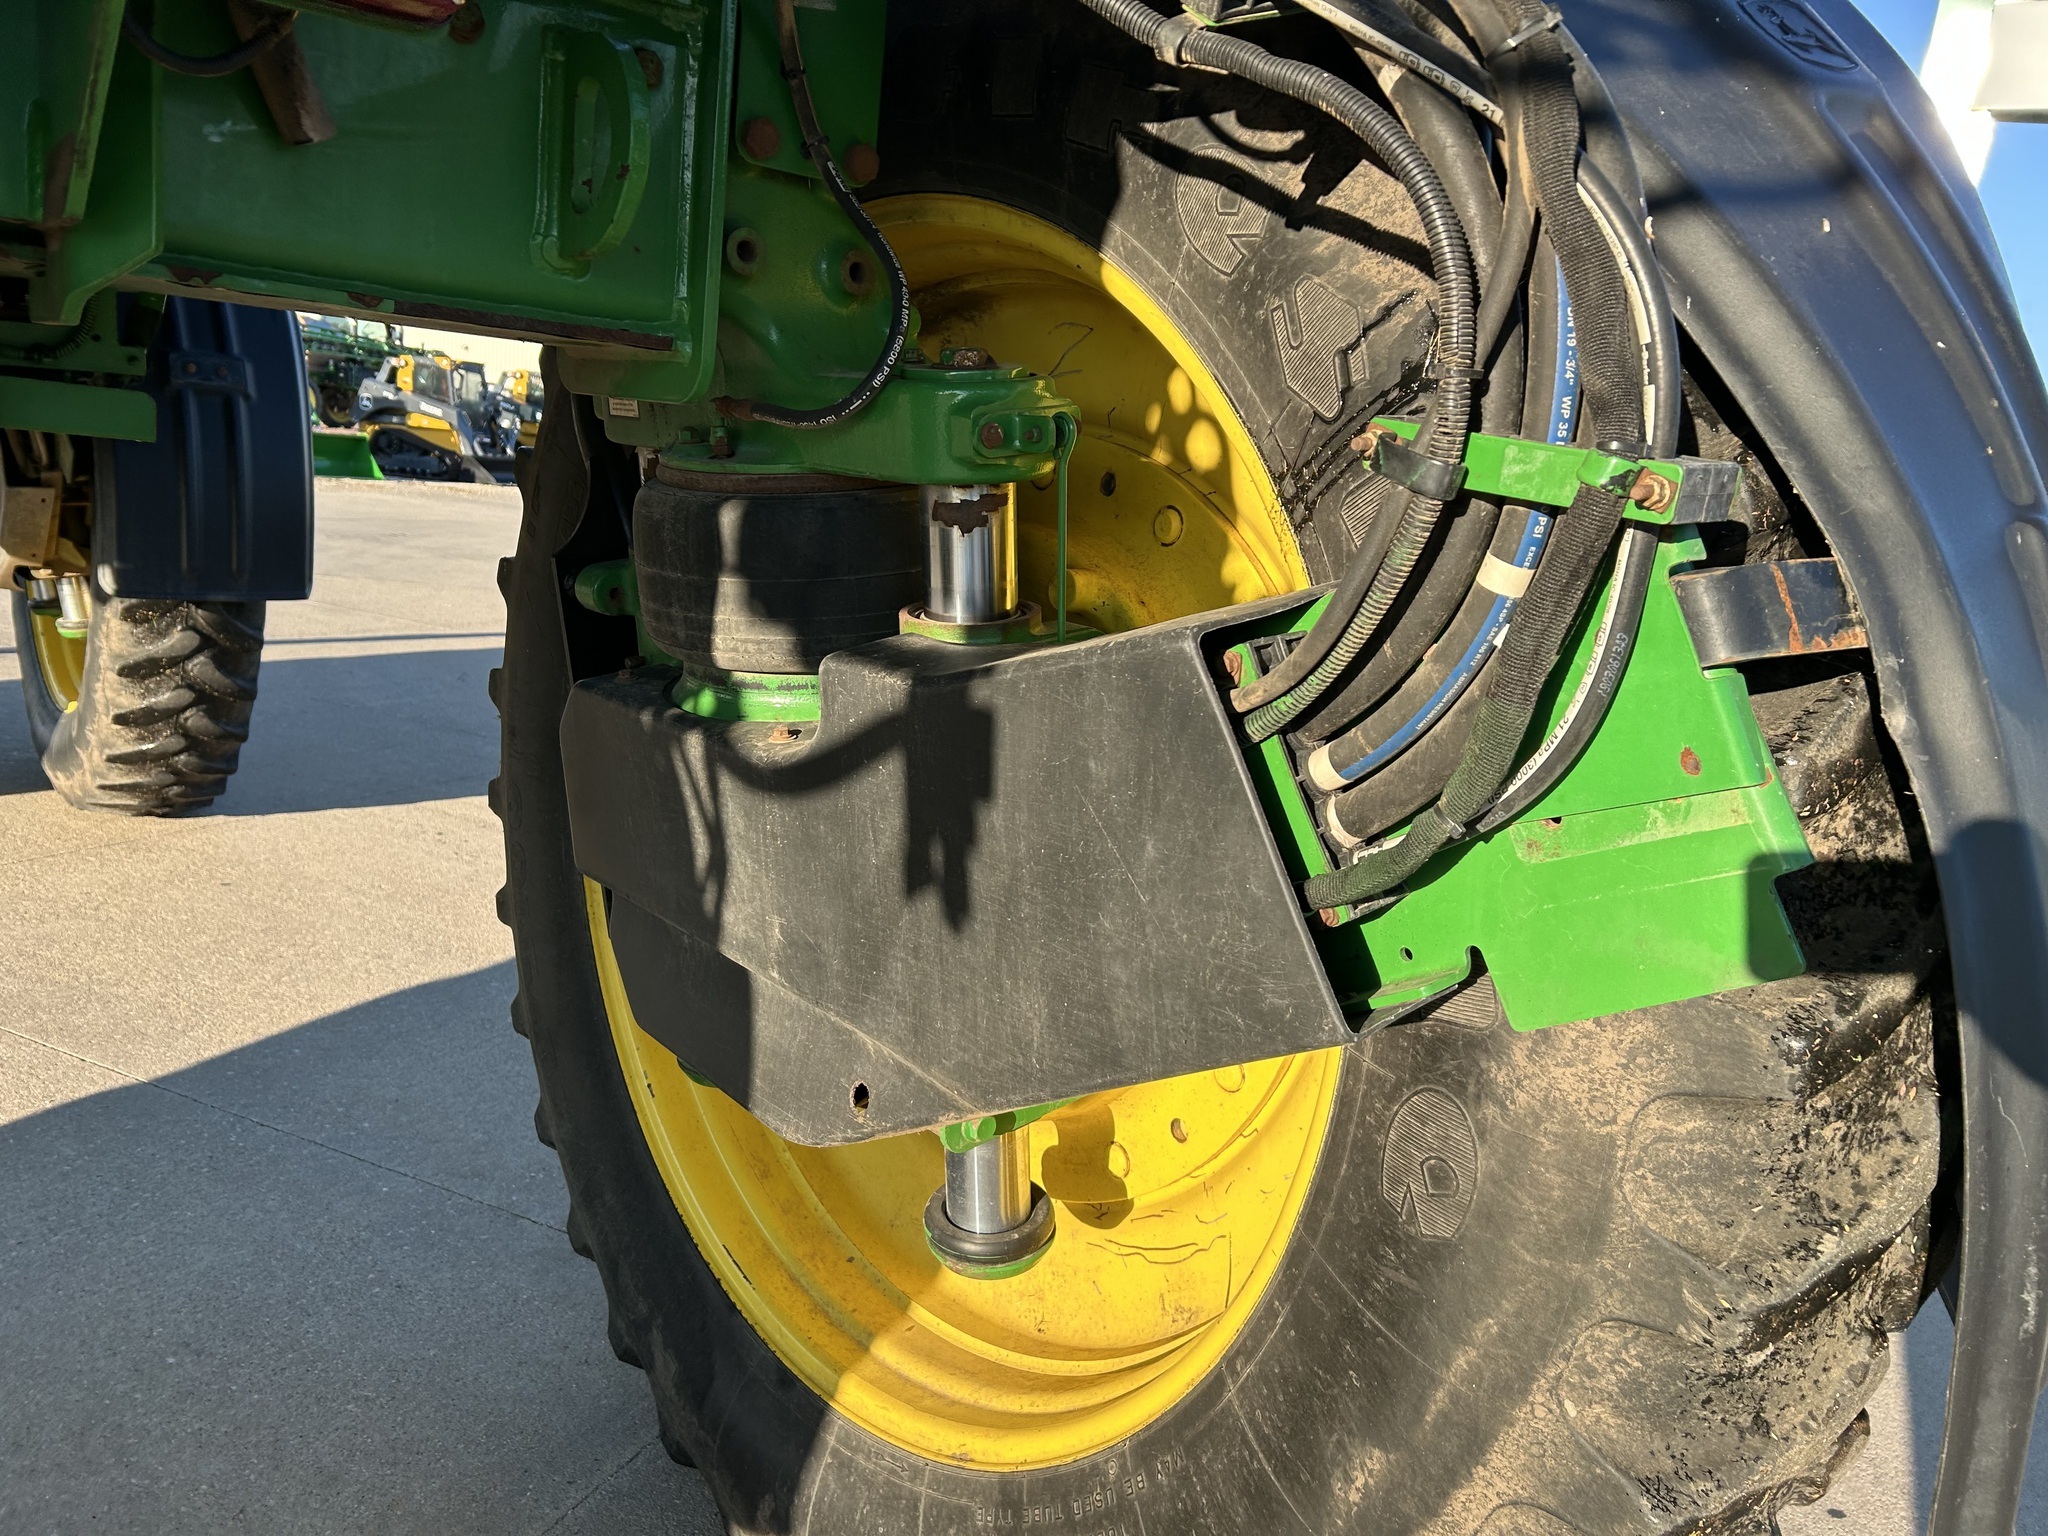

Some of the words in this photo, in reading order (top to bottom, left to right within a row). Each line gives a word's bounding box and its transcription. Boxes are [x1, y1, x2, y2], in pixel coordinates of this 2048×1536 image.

[1481, 103, 1496, 119] 21
[898, 270, 908, 287] WP
[886, 335, 905, 365] (5800
[1567, 332, 1577, 347] 19
[872, 365, 890, 389] PSI)
[1559, 395, 1573, 420] WP
[819, 415, 838, 426] ISO
[1557, 421, 1569, 438] 35
[1532, 515, 1548, 539] PSI
[1522, 546, 1539, 570] EXCE
[1486, 625, 1499, 641] SAE
[1468, 653, 1484, 667] R12
[1477, 641, 1491, 655] 100
[1441, 672, 1469, 704] ABRASION
[1414, 702, 1443, 731] RESISTANT
[1559, 716, 1570, 732] 21
[1537, 731, 1561, 758] MPa
[1511, 757, 1539, 786] (3000
[1487, 778, 1510, 805] PSI)
[1154, 1444, 1187, 1481] MAY
[1123, 1473, 1147, 1498] BE
[1022, 1502, 1065, 1526] TUBE
[1071, 1488, 1117, 1517] USED
[974, 1504, 1015, 1526] TYPE
